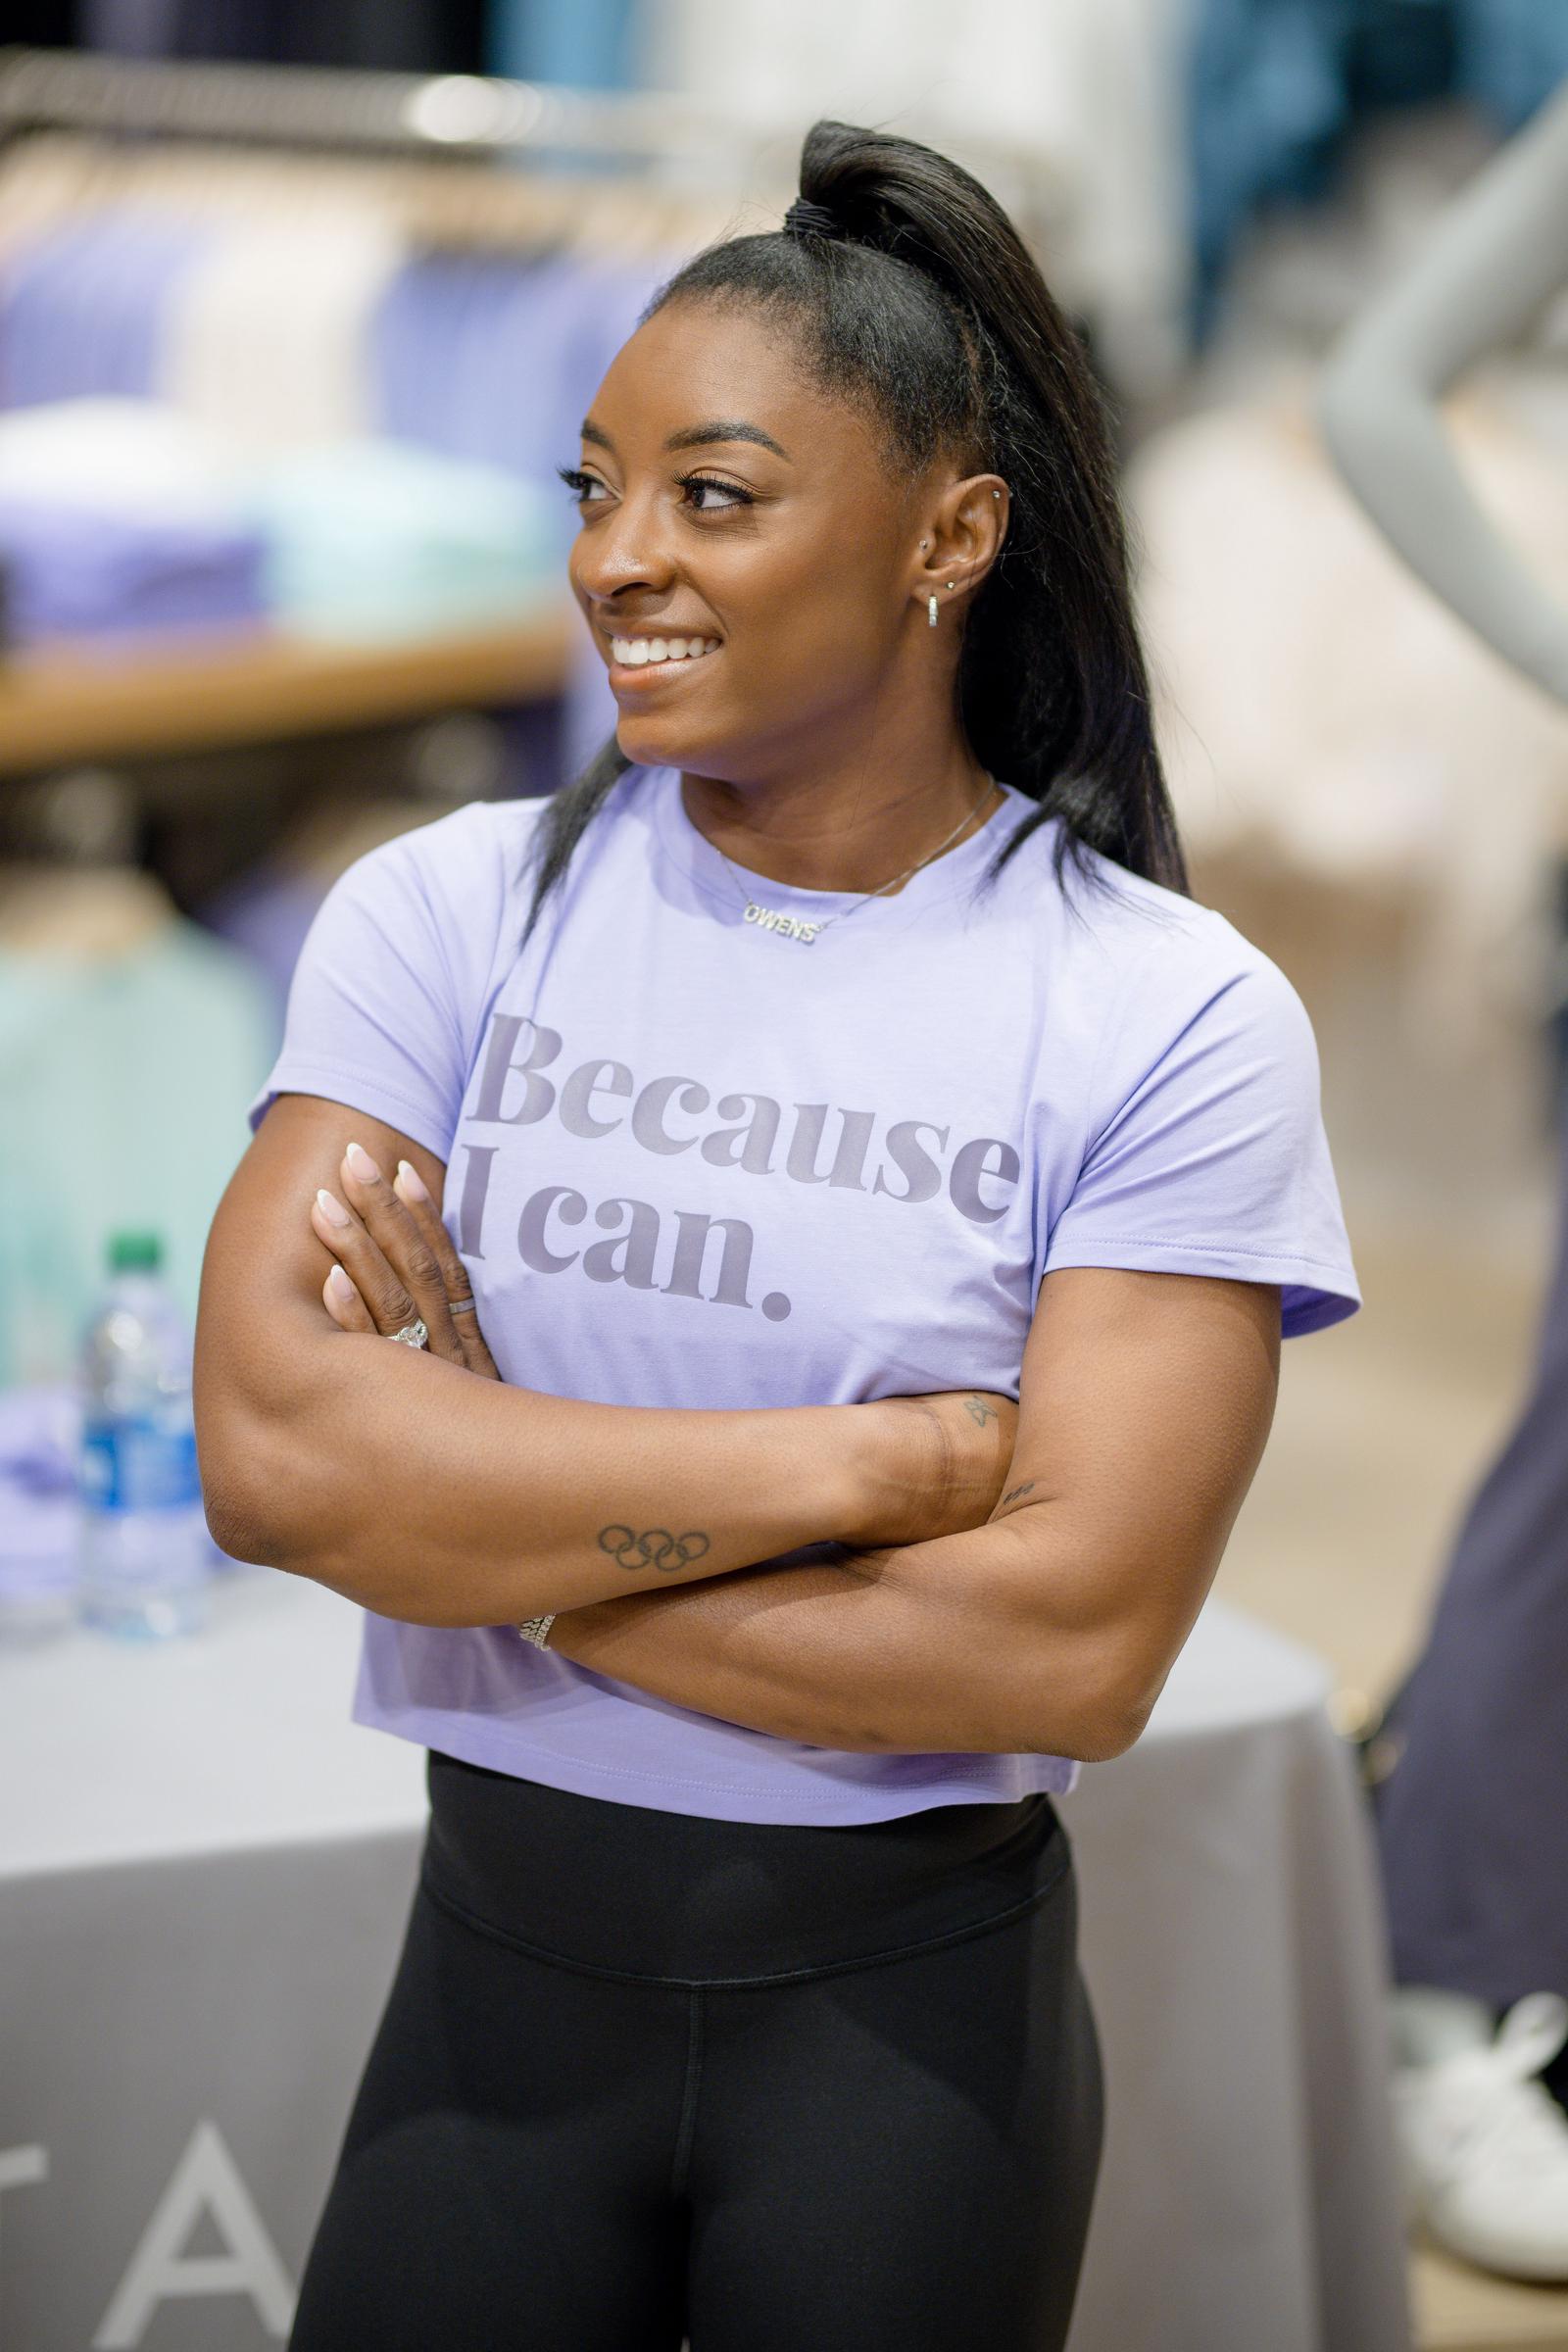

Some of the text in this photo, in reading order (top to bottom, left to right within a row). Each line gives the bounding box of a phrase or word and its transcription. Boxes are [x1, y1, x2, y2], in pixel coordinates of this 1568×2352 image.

[744, 905, 816, 943] OWENS
[466, 1012, 1020, 1223] Because
[460, 1144, 792, 1322] I can.
